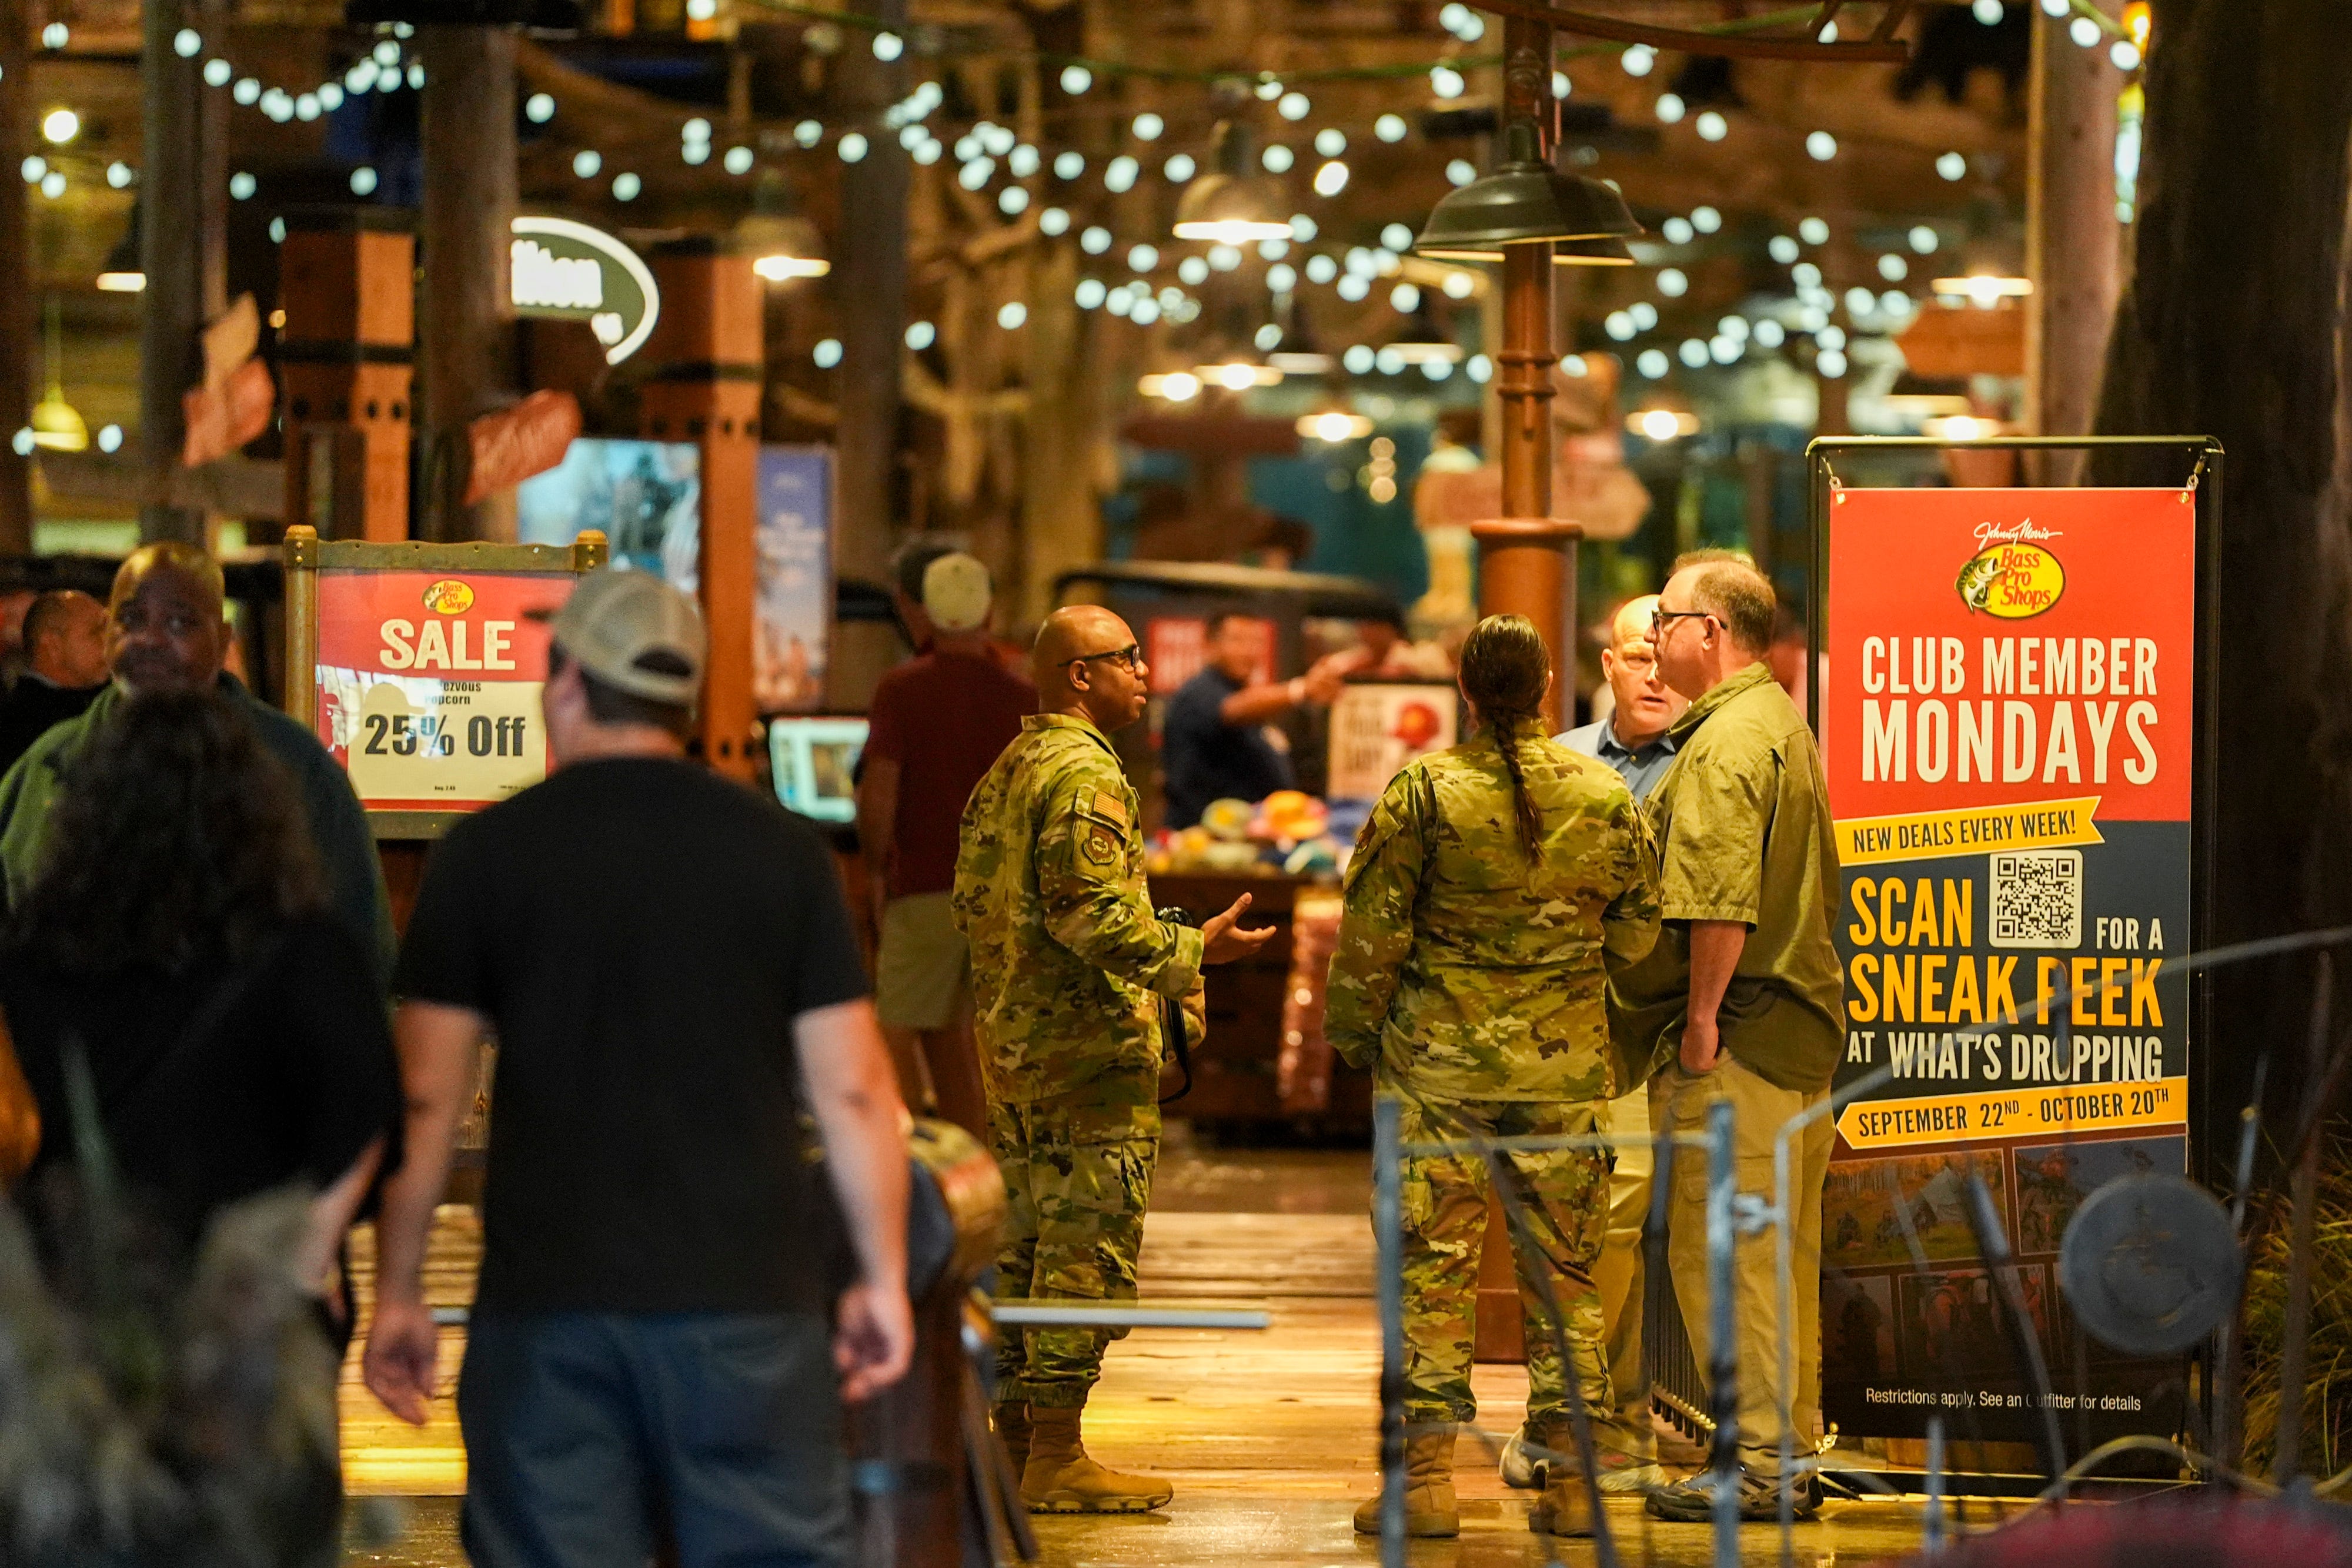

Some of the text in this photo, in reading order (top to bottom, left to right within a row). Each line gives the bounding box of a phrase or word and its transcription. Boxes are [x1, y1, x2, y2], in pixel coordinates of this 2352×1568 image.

[1974, 517, 2063, 551] Johnny Morris
[2000, 547, 2040, 568] Bass
[2000, 567, 2032, 586] Pro
[443, 582, 462, 591] Bass
[443, 599, 467, 611] Shops
[2000, 586, 2051, 610] Shops
[379, 618, 516, 670] SALE
[1862, 636, 2157, 696] CLUB MEMBER
[365, 714, 526, 757] 25% Off
[1862, 698, 2159, 785] MONDAYS
[1853, 810, 2076, 853] NEW DEALS EVERY WEEK!
[1849, 877, 2164, 950] SCAN FOR A
[1848, 953, 2164, 1027] SNEAK PEEK
[1847, 1031, 2163, 1083] AT WHAT'S DROPPING
[1859, 1106, 1968, 1137] SEPTEMBER
[2040, 1093, 2124, 1122] OCTOBER
[1866, 1388, 1937, 1405] Restrictions
[1941, 1390, 1976, 1409] apply.
[1979, 1391, 2003, 1407] See
[2007, 1395, 2022, 1407] an
[2080, 1394, 2097, 1409] for
[2100, 1395, 2141, 1410] details
